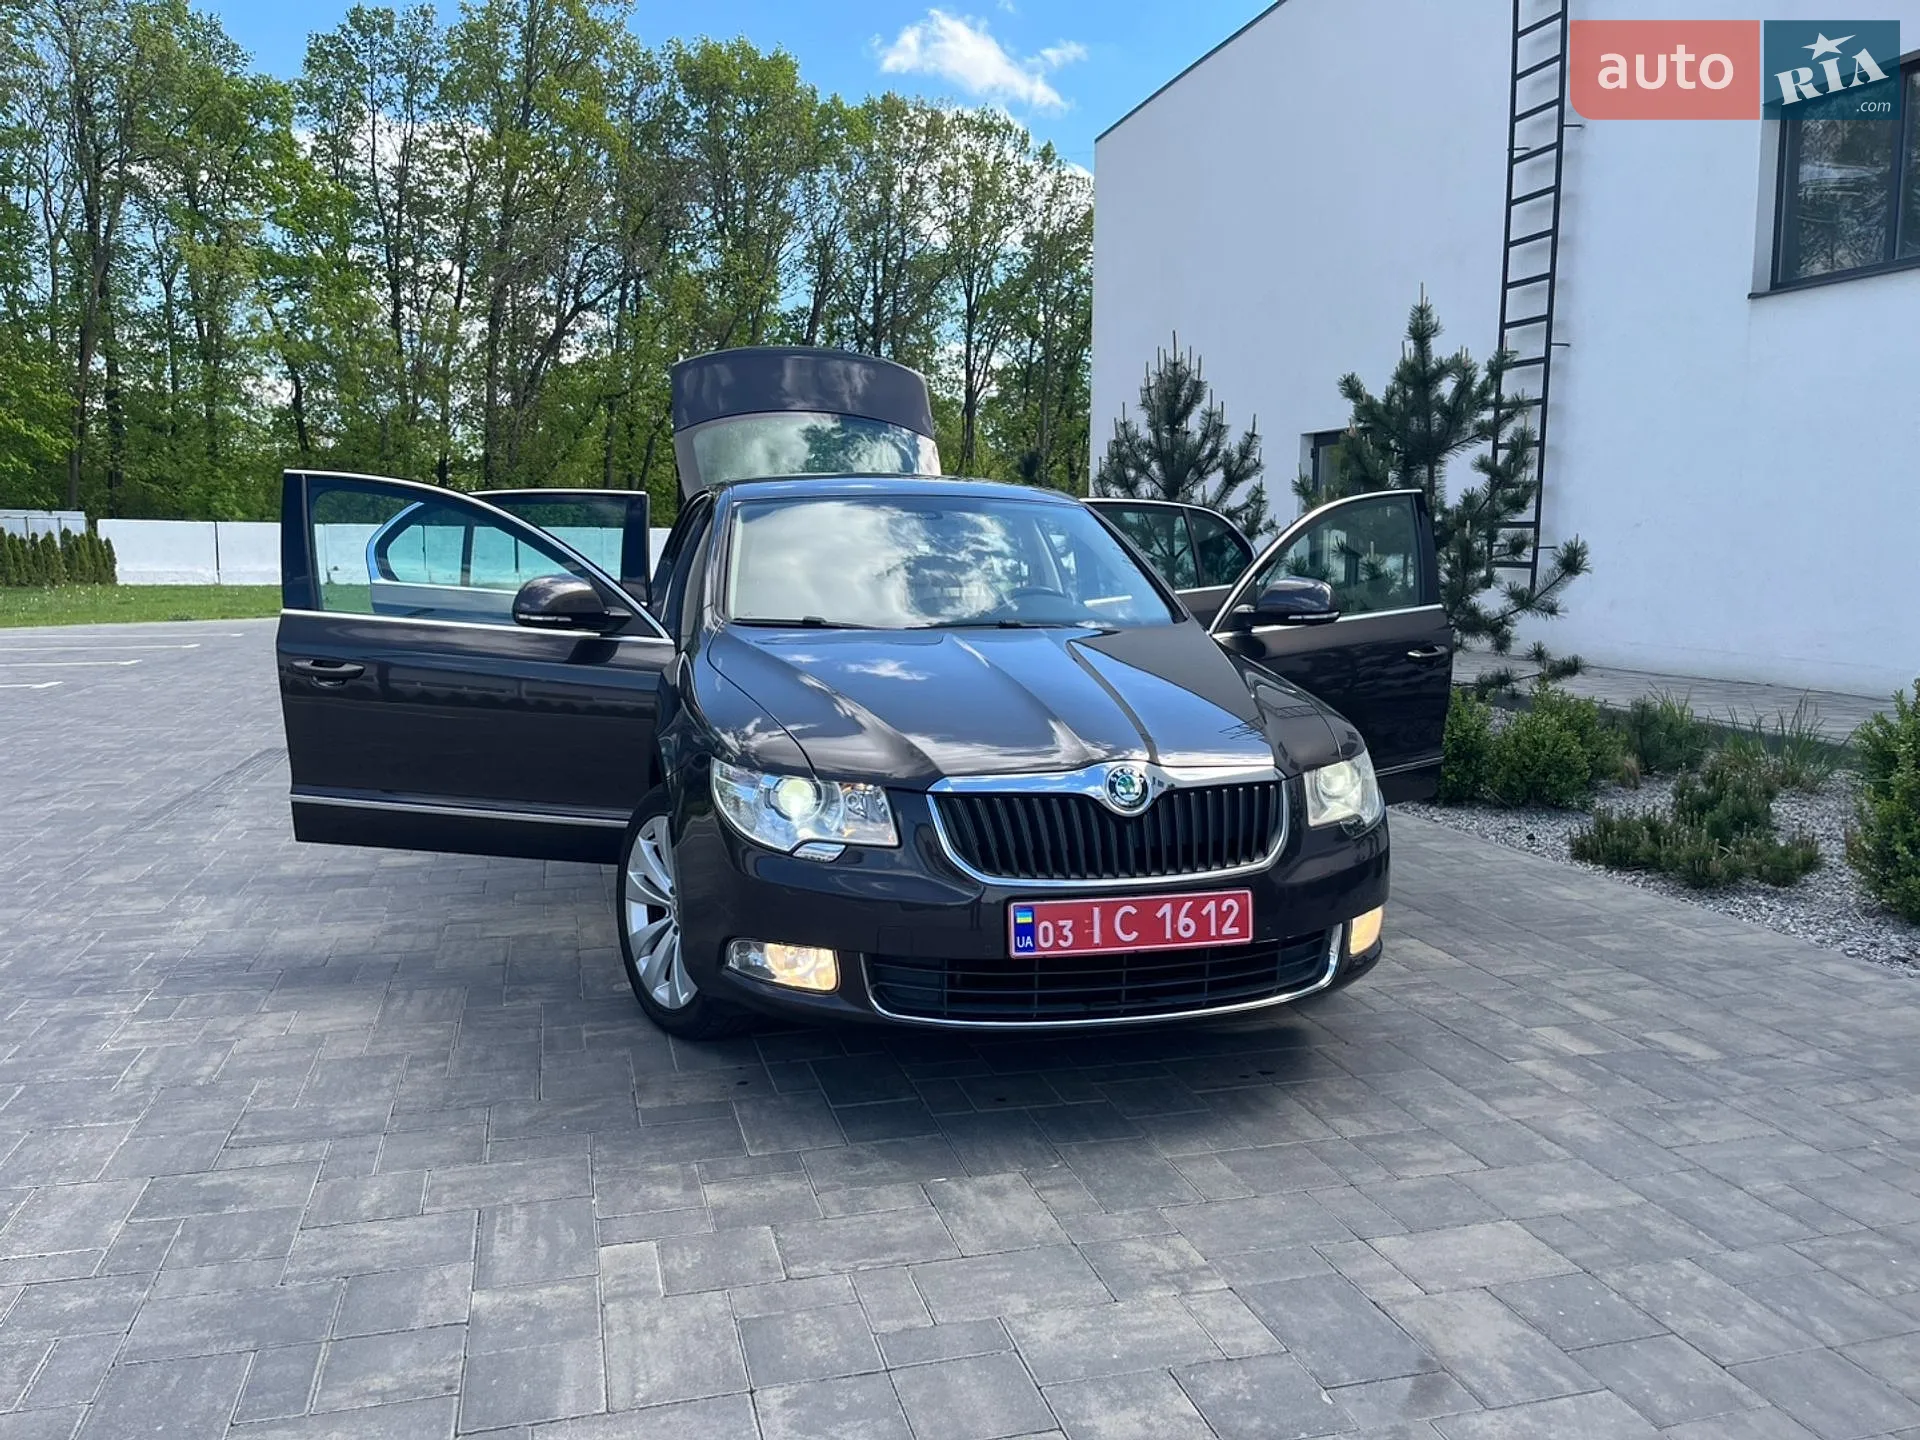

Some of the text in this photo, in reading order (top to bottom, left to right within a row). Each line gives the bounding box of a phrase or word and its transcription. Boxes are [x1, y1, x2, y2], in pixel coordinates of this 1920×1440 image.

[1038, 919, 1073, 948] 03
[1155, 898, 1240, 939] 1612
[1016, 936, 1034, 948] UA
